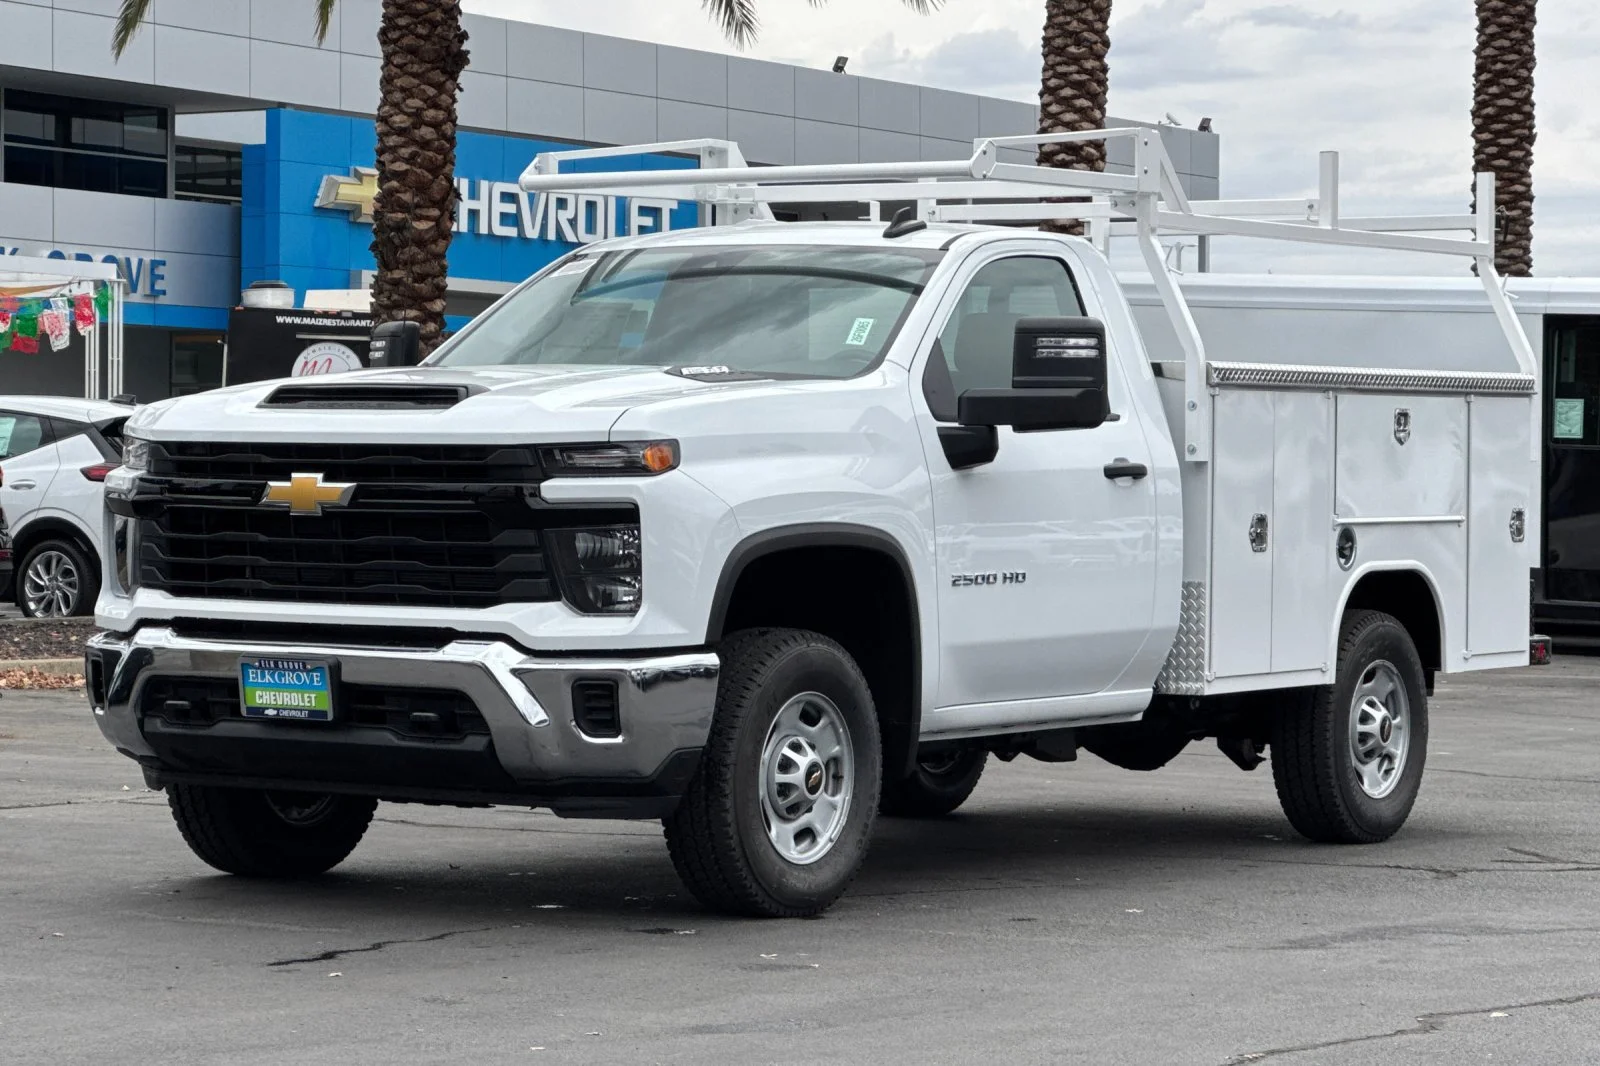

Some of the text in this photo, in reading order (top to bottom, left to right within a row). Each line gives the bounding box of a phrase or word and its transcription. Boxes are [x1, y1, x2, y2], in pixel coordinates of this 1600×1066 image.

[451, 176, 679, 244] HEVROLET
[951, 572, 1026, 587] 2500 HD
[261, 660, 303, 670] ELK GROVE
[255, 690, 316, 707] CHEVROLET
[278, 709, 309, 718] CHEVROLET
